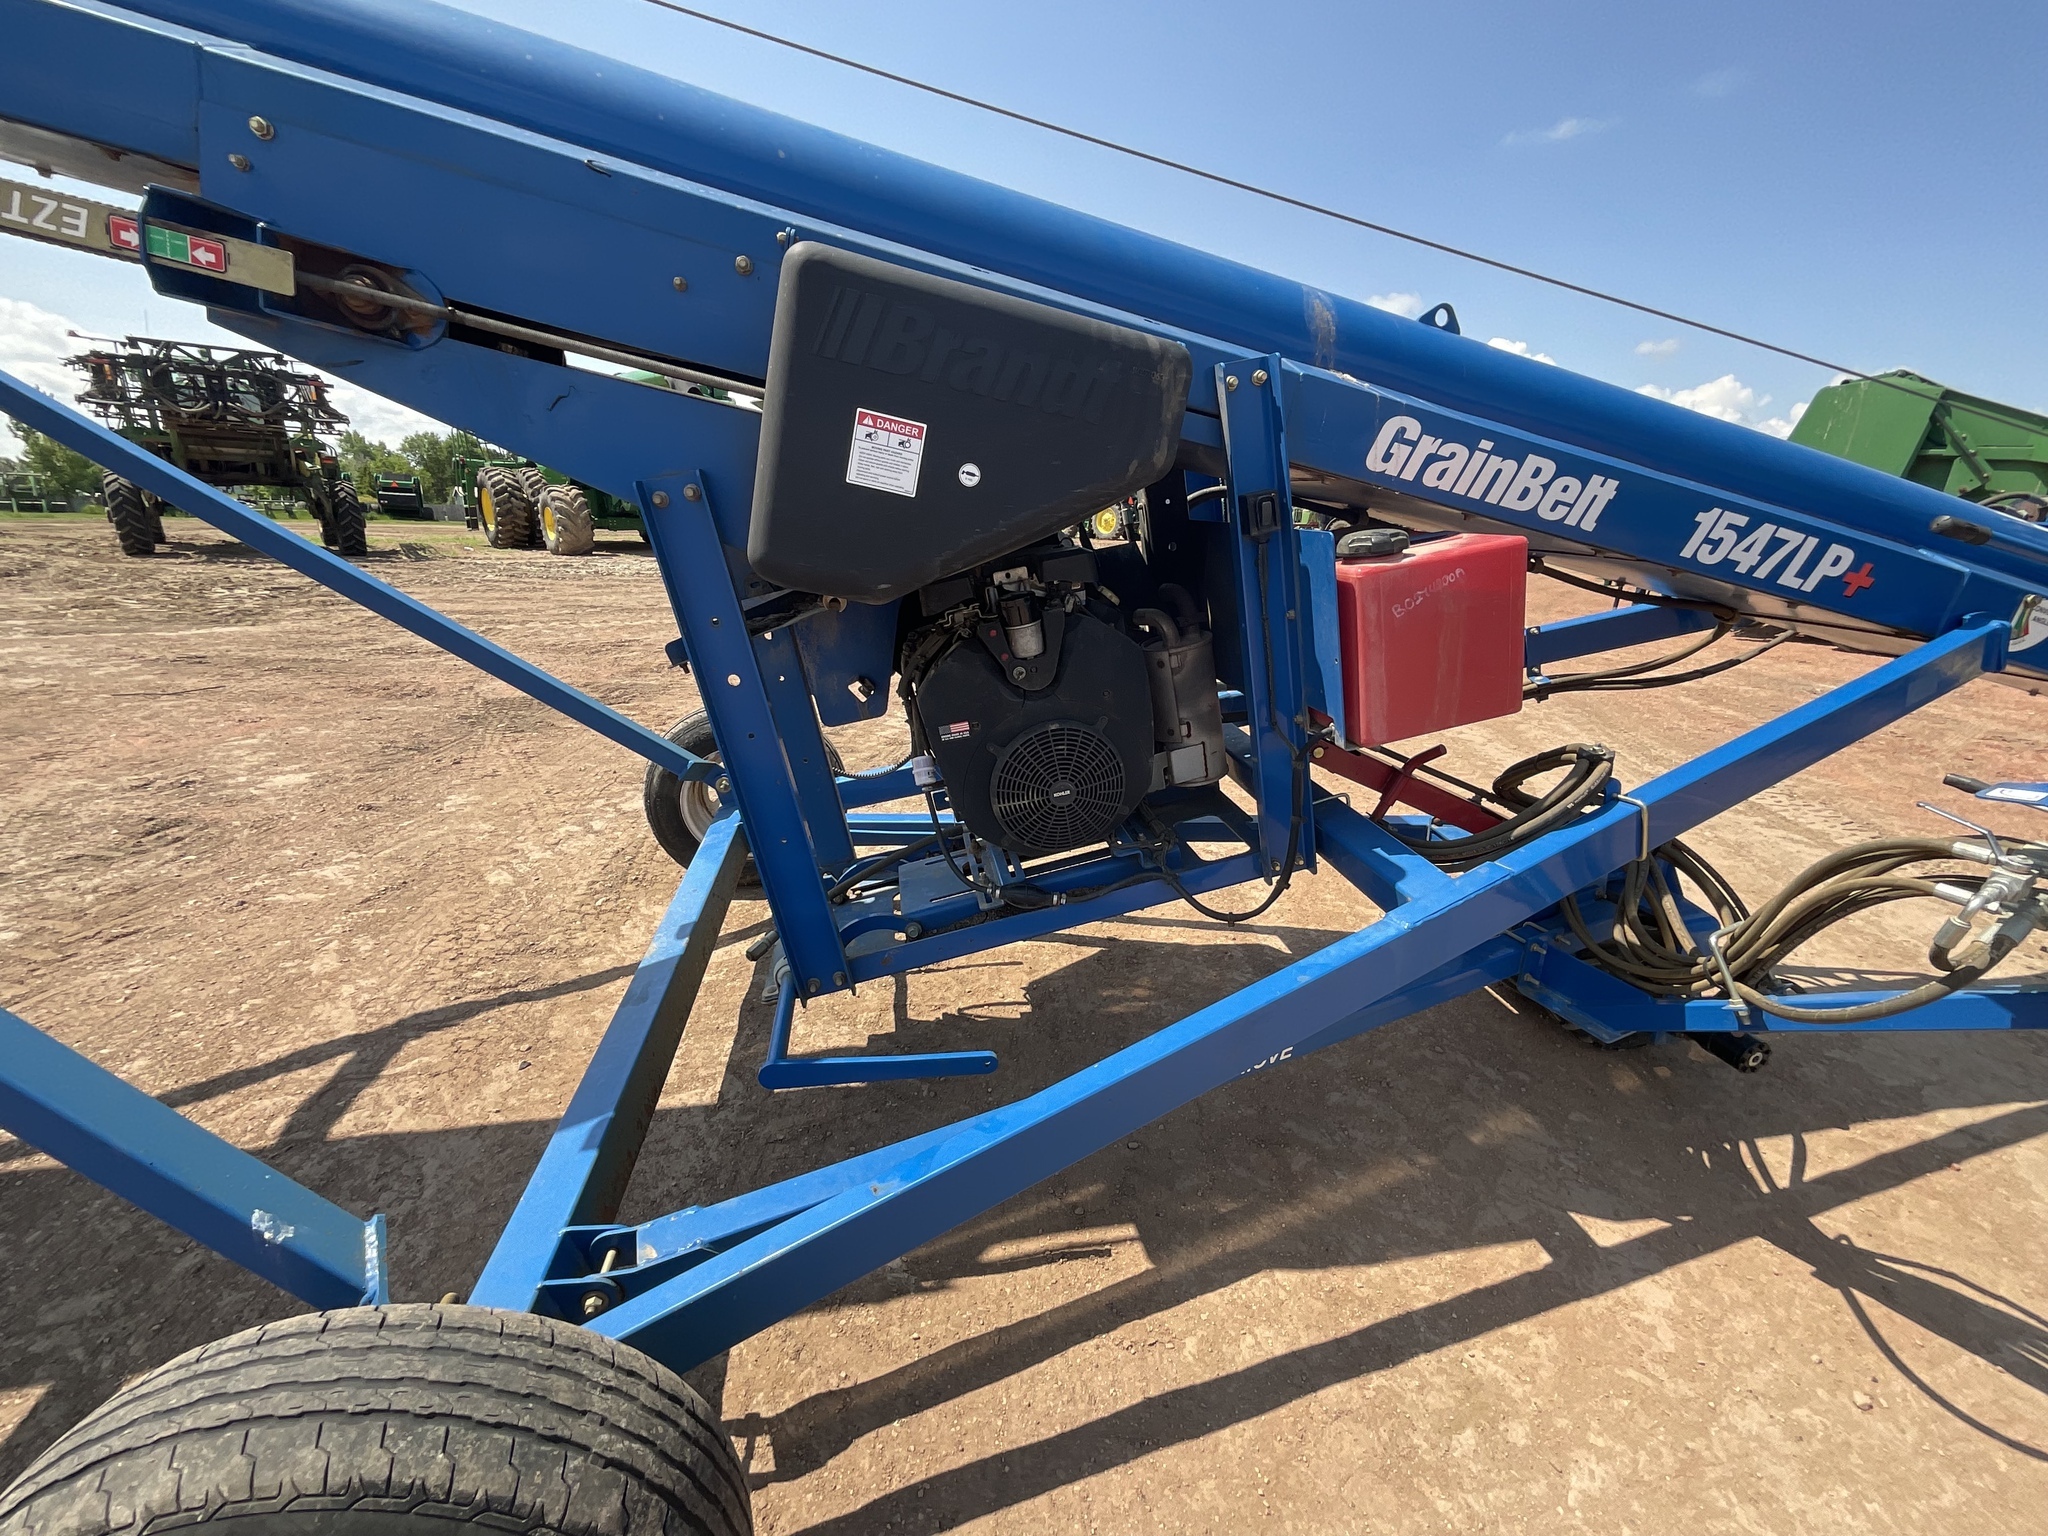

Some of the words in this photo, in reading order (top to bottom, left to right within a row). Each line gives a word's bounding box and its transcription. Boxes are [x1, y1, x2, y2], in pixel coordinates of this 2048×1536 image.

[864, 301, 1122, 425] Brandt
[876, 418, 919, 437] DANGER
[1365, 415, 1620, 532] GrainBelt
[1679, 507, 1875, 597] 1547LP+
